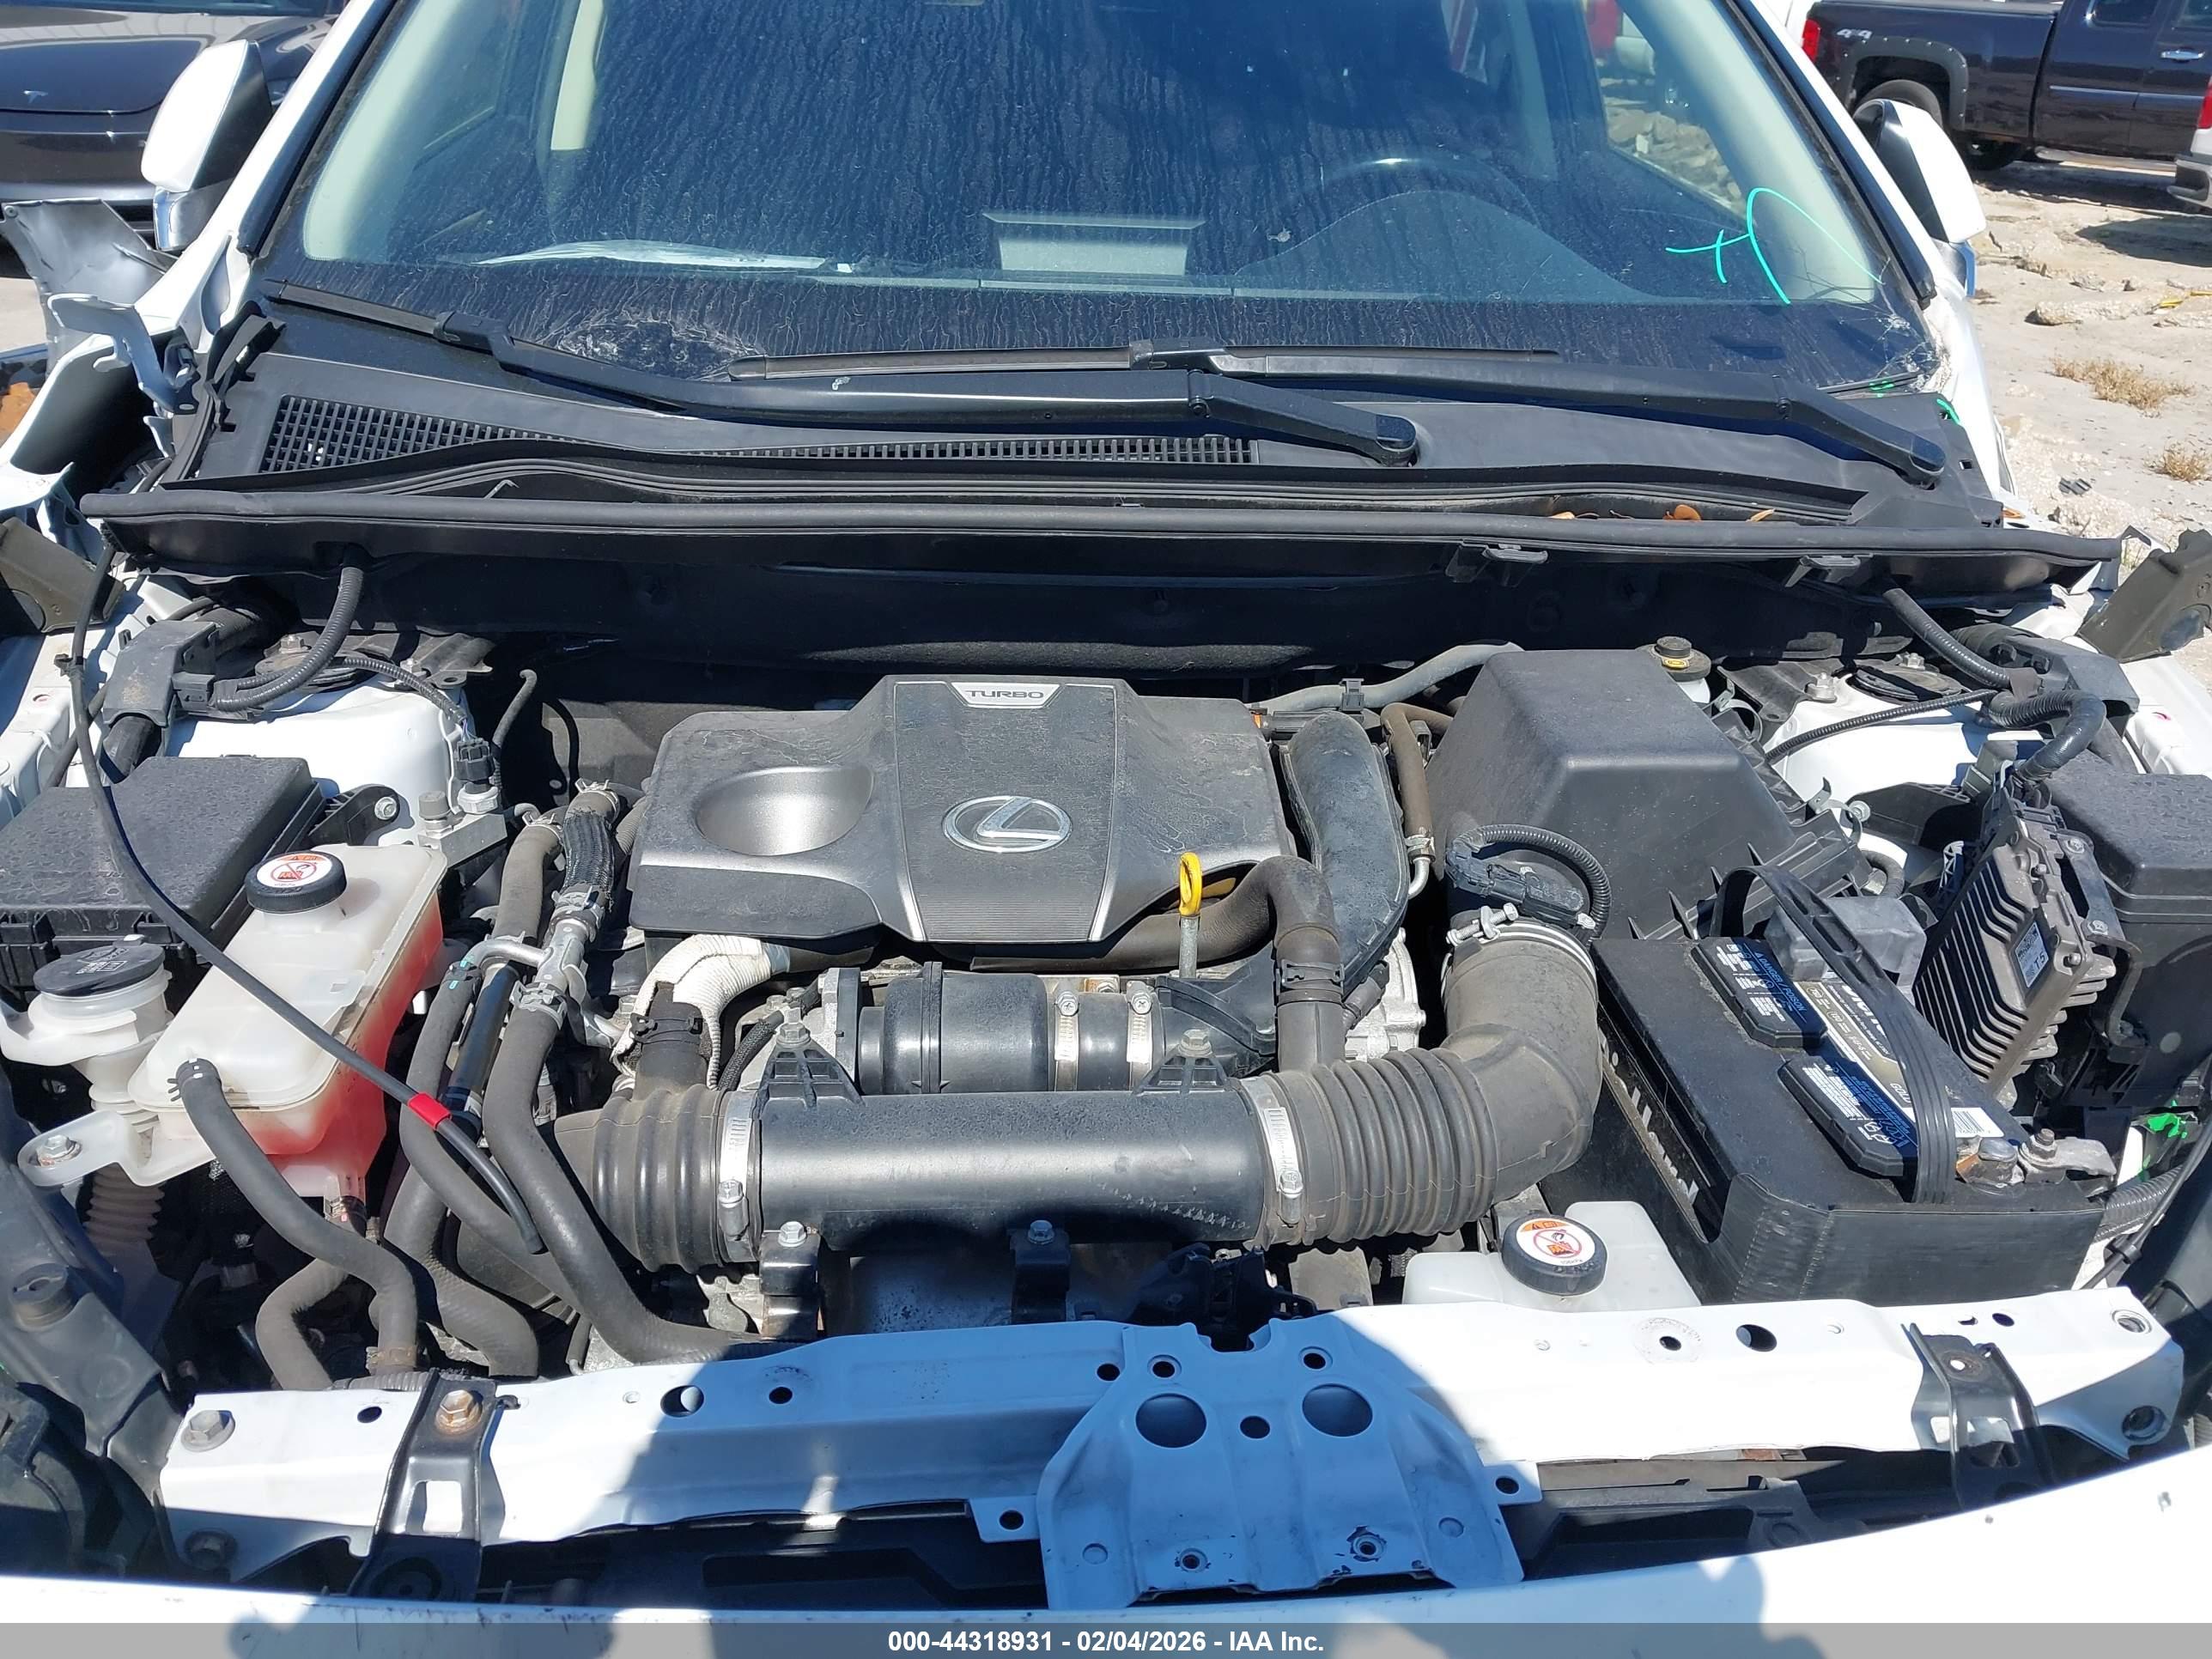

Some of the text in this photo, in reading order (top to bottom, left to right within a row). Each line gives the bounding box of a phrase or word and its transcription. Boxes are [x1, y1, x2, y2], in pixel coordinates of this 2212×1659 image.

[964, 690, 1044, 699] TURBO
[1759, 957, 1784, 987] DANGER
[1782, 987, 1808, 1012] POISON
